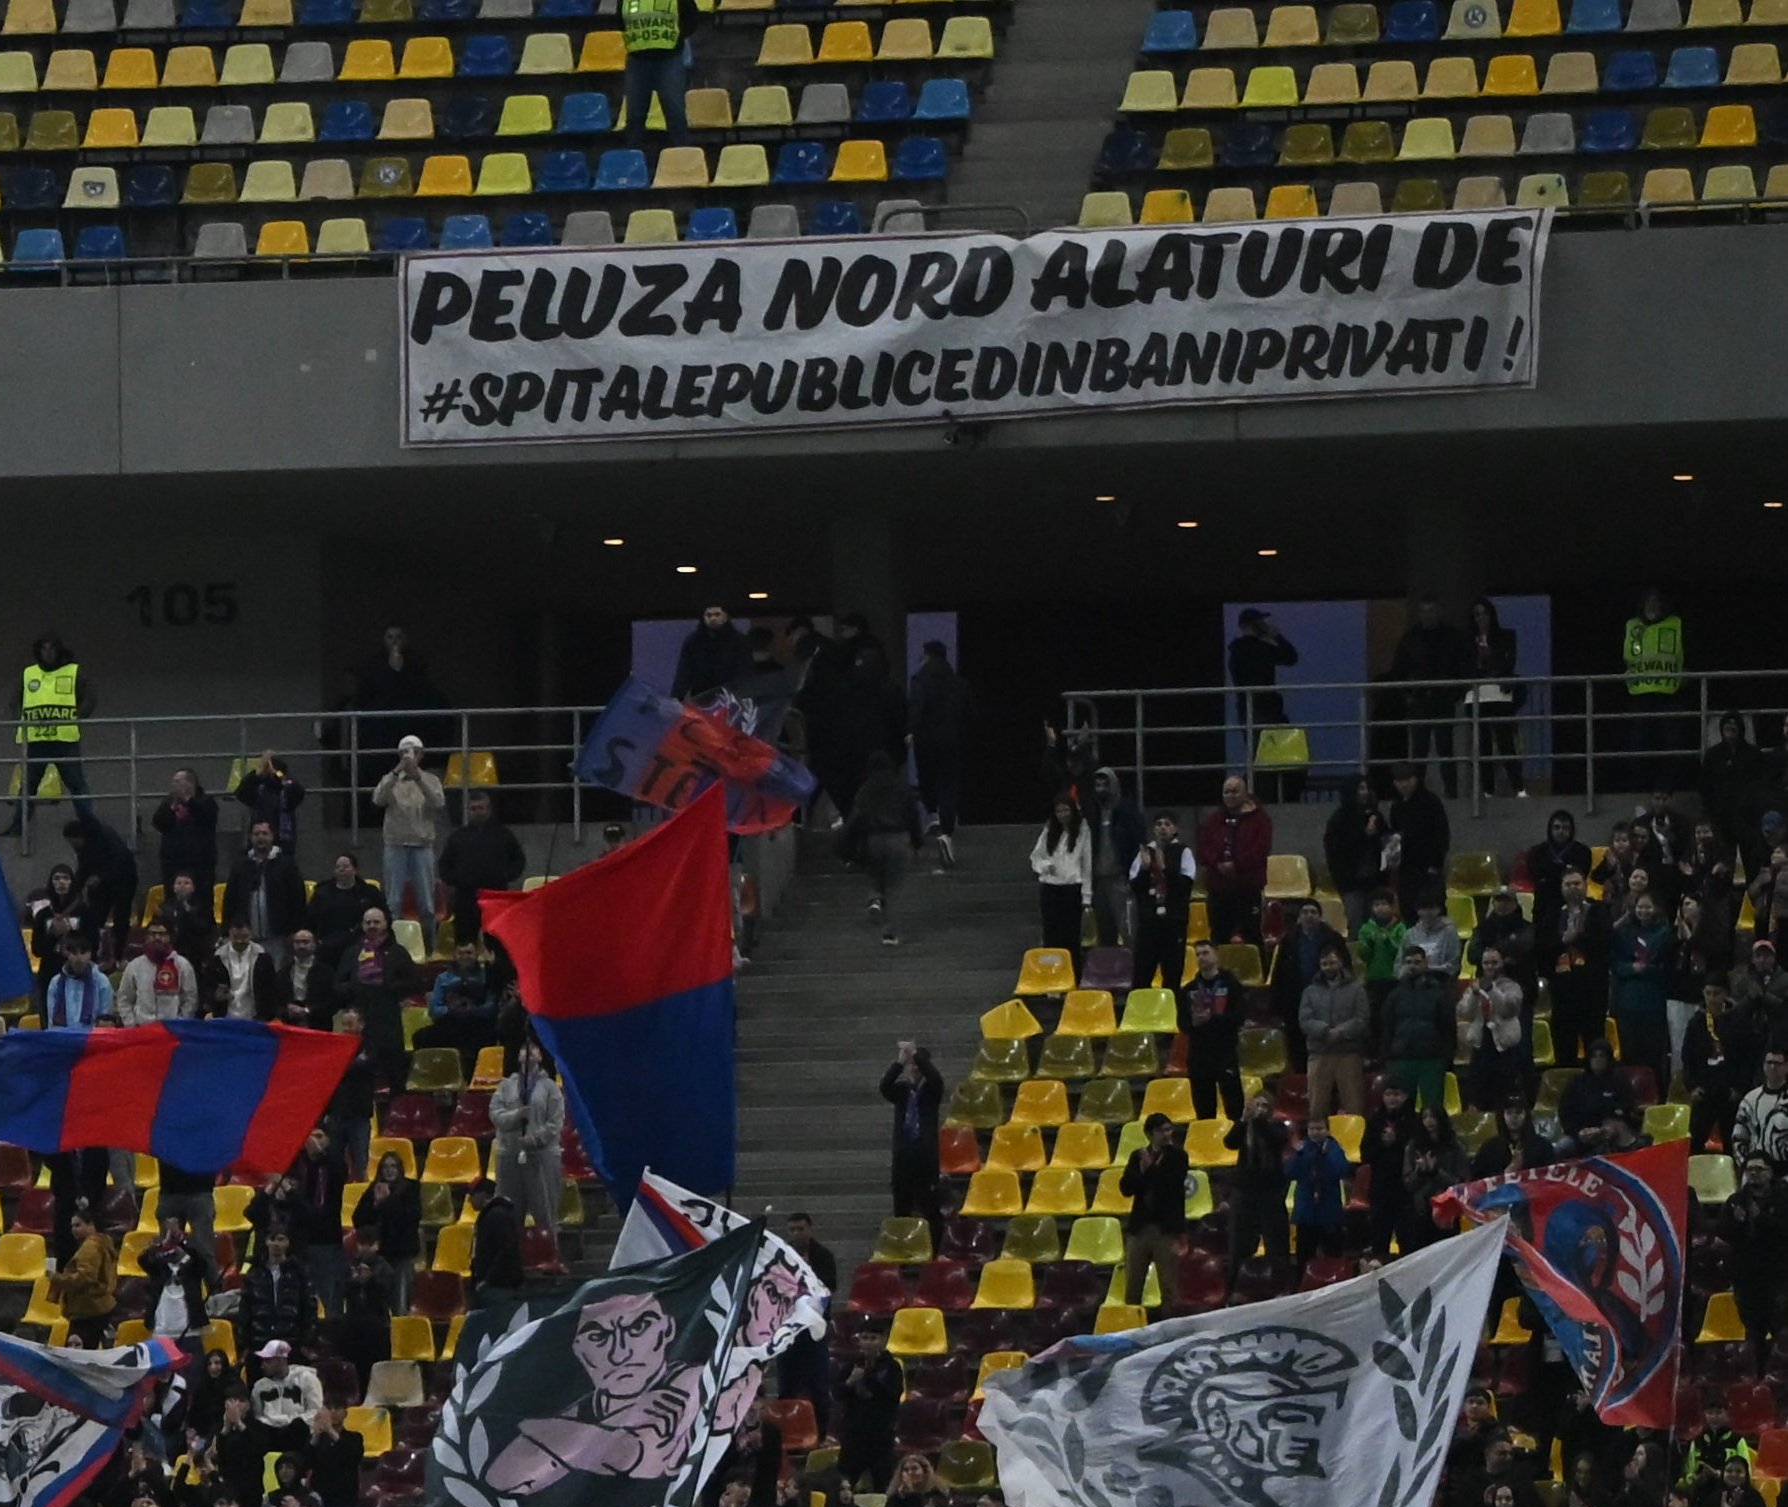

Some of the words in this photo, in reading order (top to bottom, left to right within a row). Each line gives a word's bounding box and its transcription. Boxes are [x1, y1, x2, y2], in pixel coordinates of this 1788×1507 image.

[762, 242, 1012, 334] NORD
[1031, 222, 1386, 313] ALATURI
[1411, 214, 1525, 289] DE
[419, 317, 1492, 429] #SPITALEPUBLICEDINBANIPRIVATI
[1503, 316, 1523, 372] !
[126, 583, 238, 627] 105
